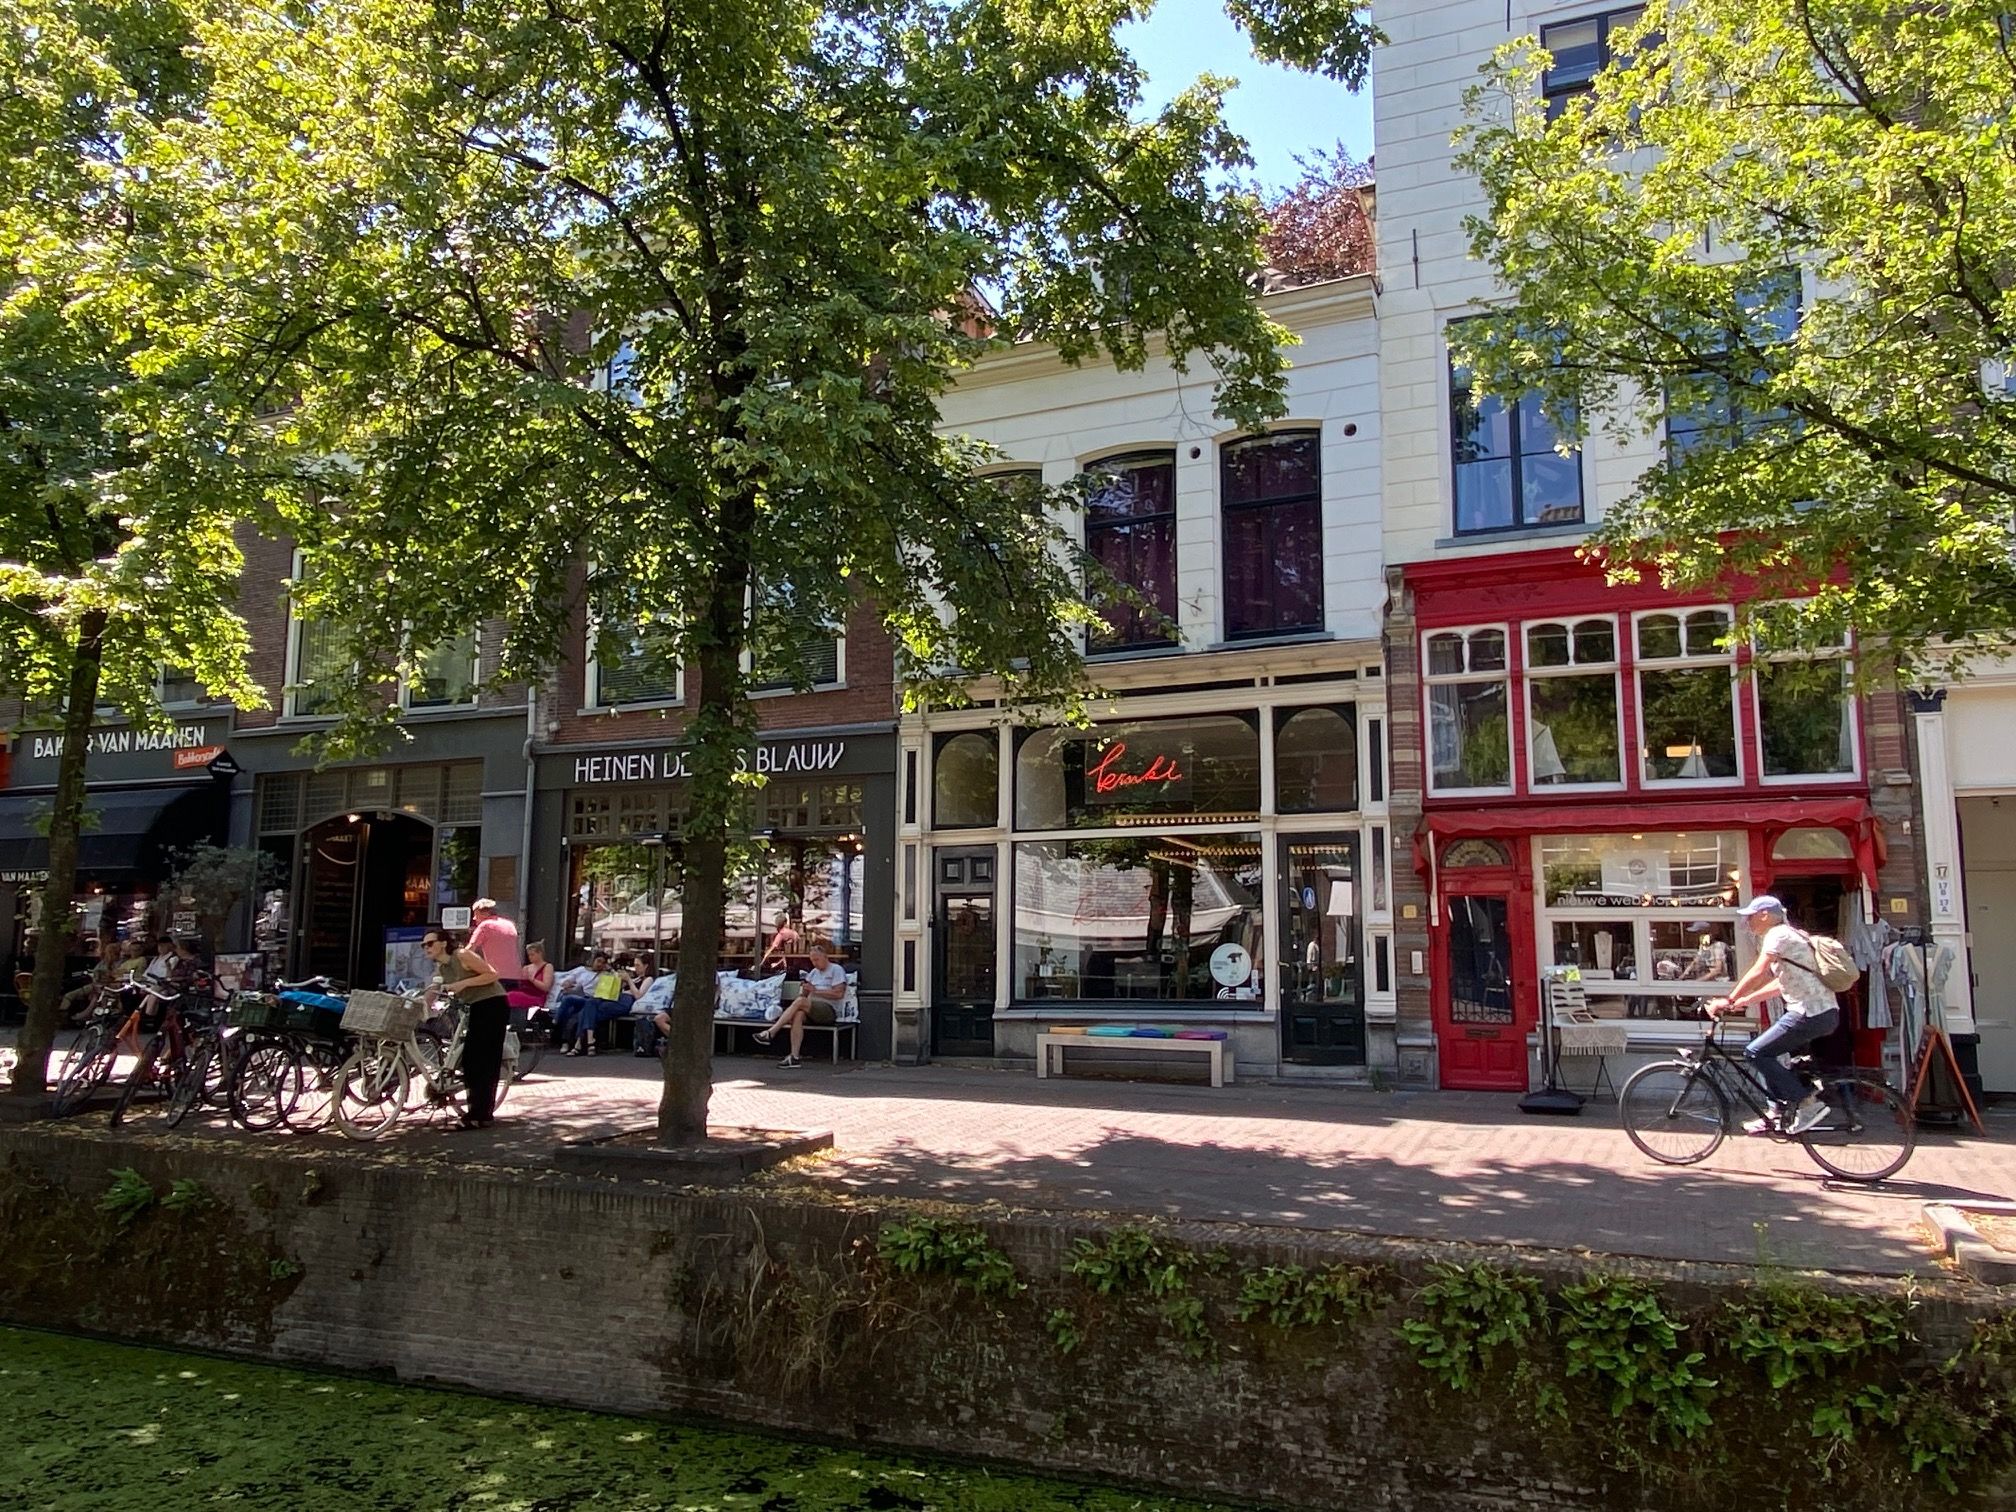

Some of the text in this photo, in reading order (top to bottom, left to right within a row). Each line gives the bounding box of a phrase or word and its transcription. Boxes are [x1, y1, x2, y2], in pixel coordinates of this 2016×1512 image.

[99, 731, 130, 753] VAN
[135, 726, 205, 751] MAANEN
[574, 742, 844, 783] HEINEN DES BLAUW
[1936, 866, 1948, 878] 17
[1556, 894, 1607, 907] nieuwe
